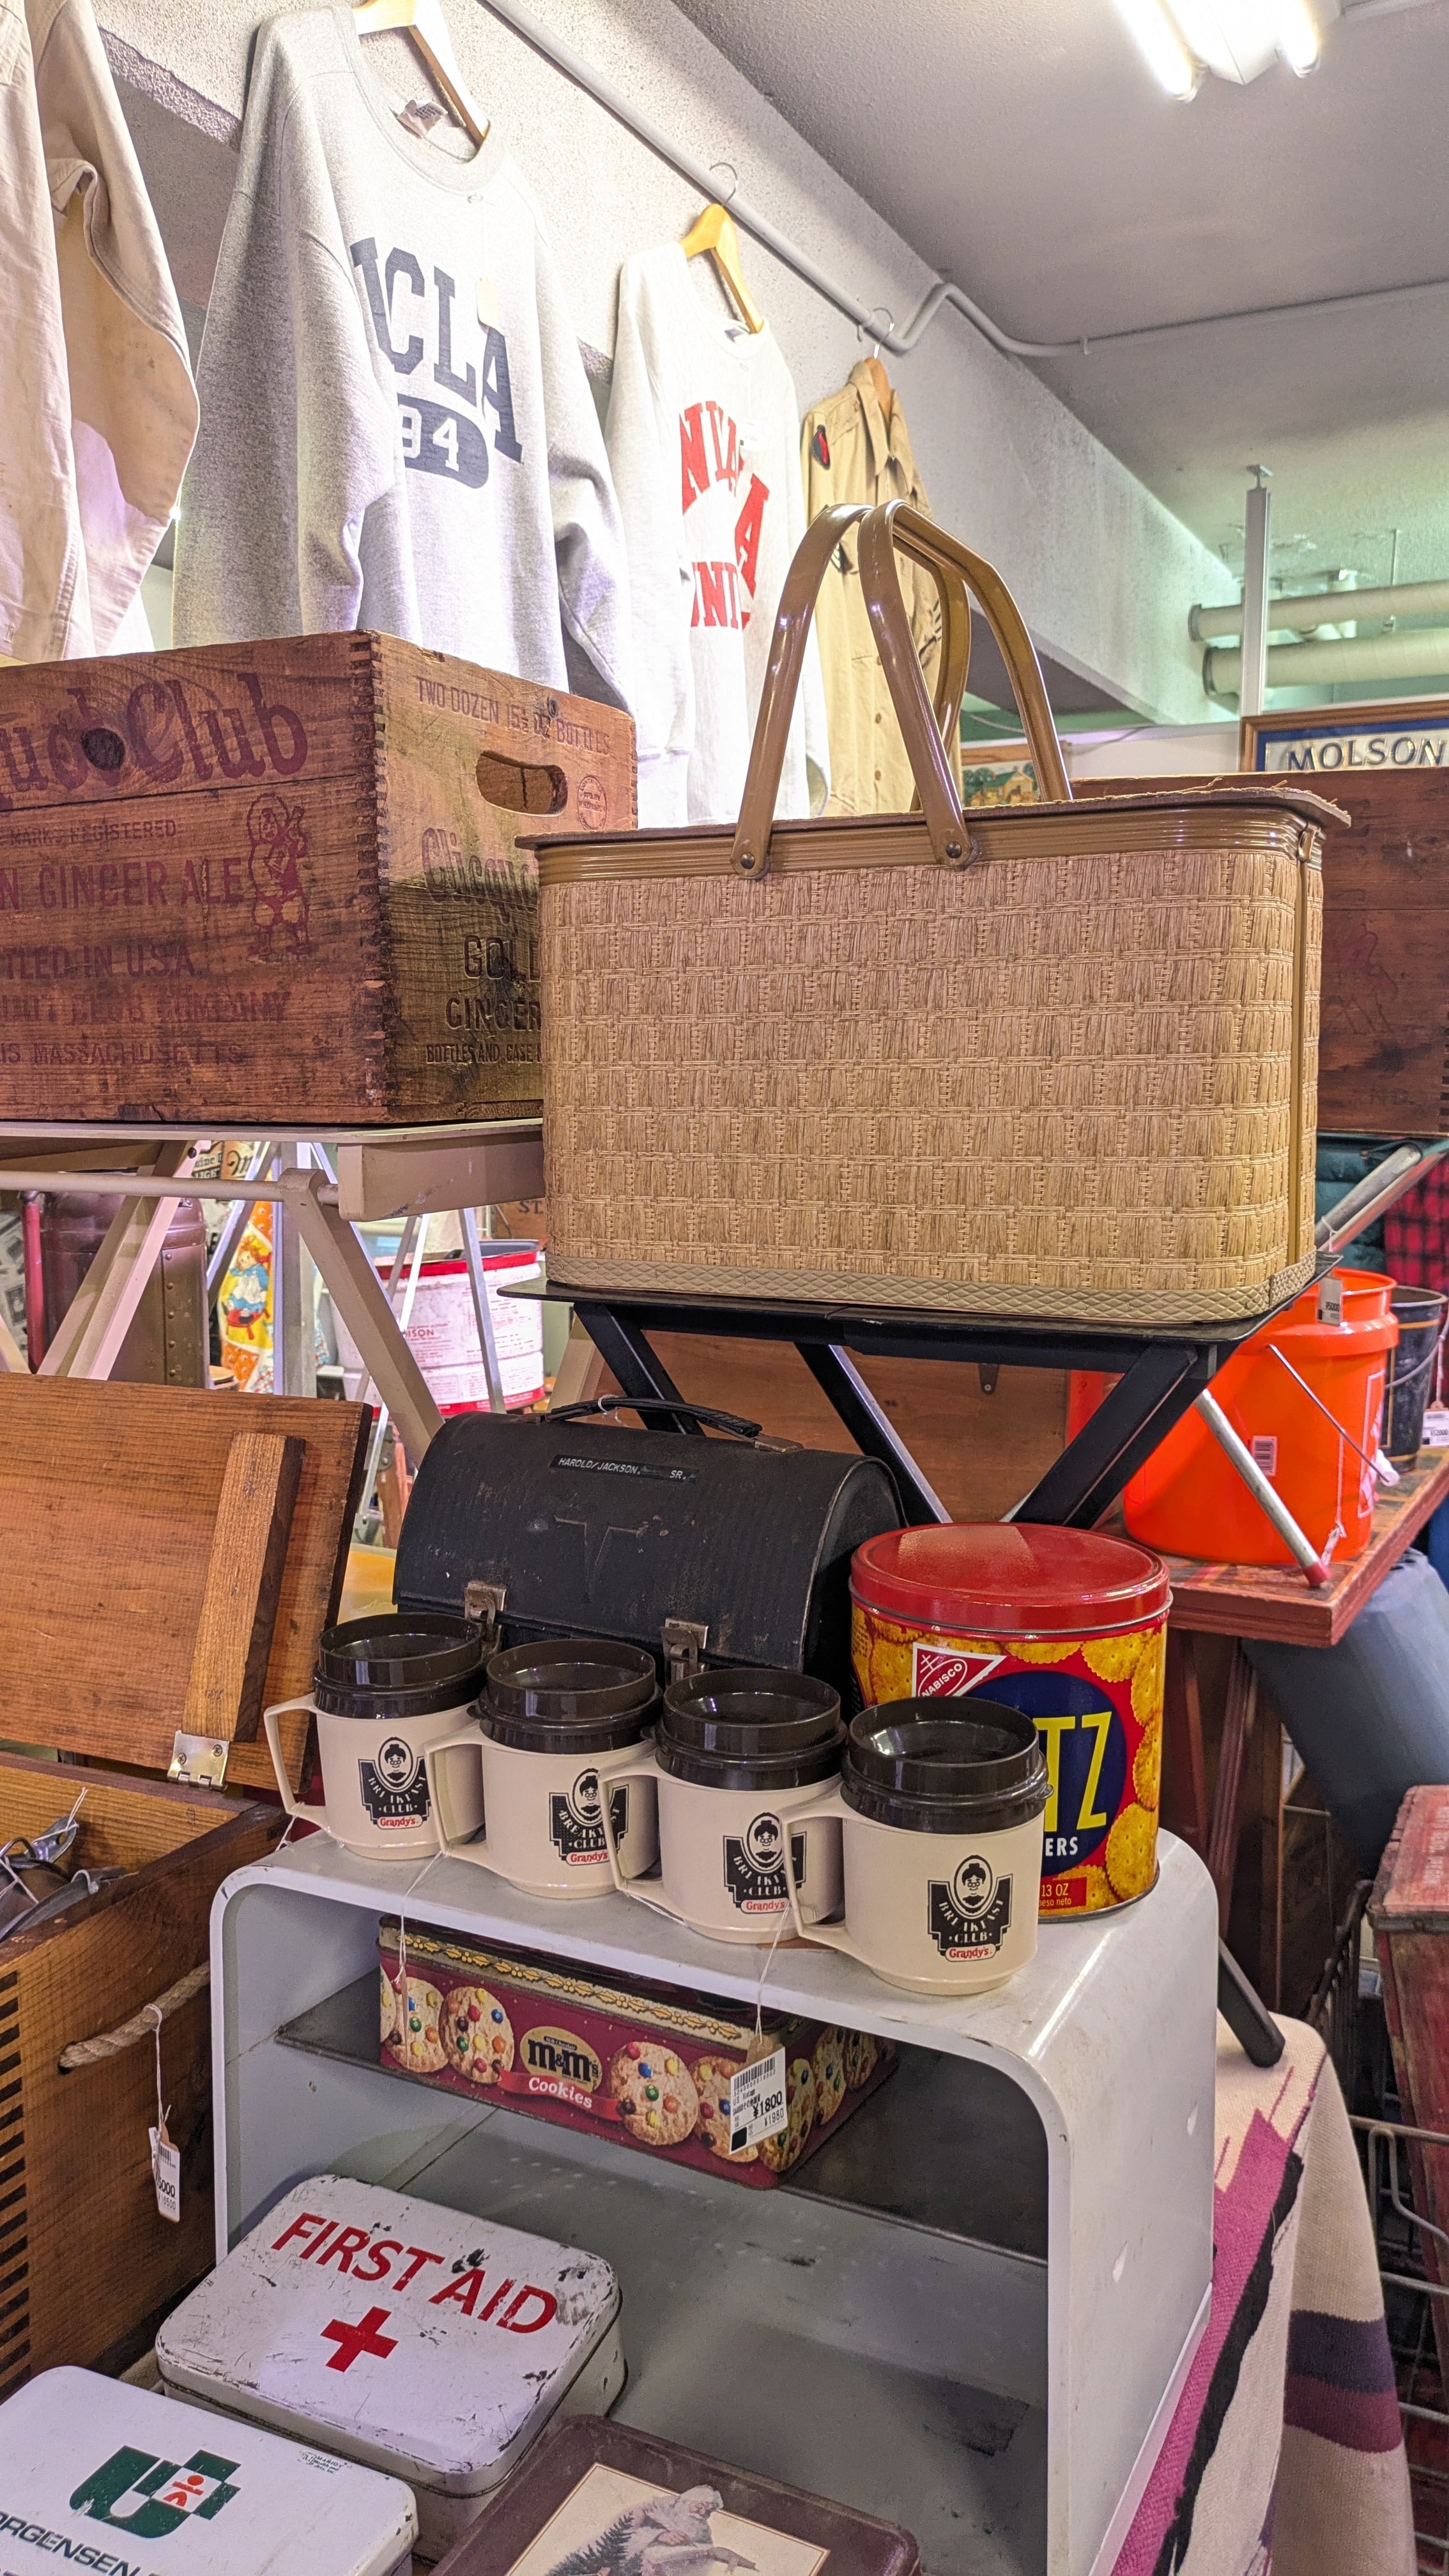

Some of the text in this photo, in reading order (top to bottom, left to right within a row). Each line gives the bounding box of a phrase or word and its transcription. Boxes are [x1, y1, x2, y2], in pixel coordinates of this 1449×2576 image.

[417, 677, 447, 709] TWO
[450, 686, 500, 724] DOZEN
[556, 718, 611, 755] BOTTLES
[128, 673, 308, 783] Club
[1288, 737, 1447, 771] MOLSON
[70, 819, 177, 844] REGISTERED
[39, 860, 169, 910] GINGER
[180, 857, 245, 905] ALE
[82, 944, 114, 979] IN
[158, 992, 291, 1023] COMPANY
[33, 1042, 245, 1067] MASSACHUSETTS
[426, 1043, 476, 1064] BOTTLES
[477, 1043, 501, 1064] AND
[505, 1043, 533, 1064] CASE
[406, 1329, 434, 1338] ISON
[669, 1469, 687, 1480] SR.
[921, 1663, 963, 1697] NABISCO
[383, 1804, 414, 1814] CLUB
[379, 1816, 417, 1827] Grandy's
[573, 1837, 606, 1849] CLUB
[570, 1850, 608, 1863] Grandy's
[748, 1885, 781, 1896] CLUB
[1041, 1883, 1070, 1897] 13 OZ
[746, 1900, 785, 1912] Grandy's
[1056, 1897, 1072, 1906] neto
[939, 1899, 1004, 1932] BREAKFAST
[954, 1931, 988, 1943] CLUB
[948, 1946, 990, 1959] Grandy's
[528, 2076, 593, 2109] Cookies
[753, 2090, 783, 2119] ¥1800
[763, 2107, 785, 2128] ¥1980
[271, 2212, 558, 2334] FIRST AID
